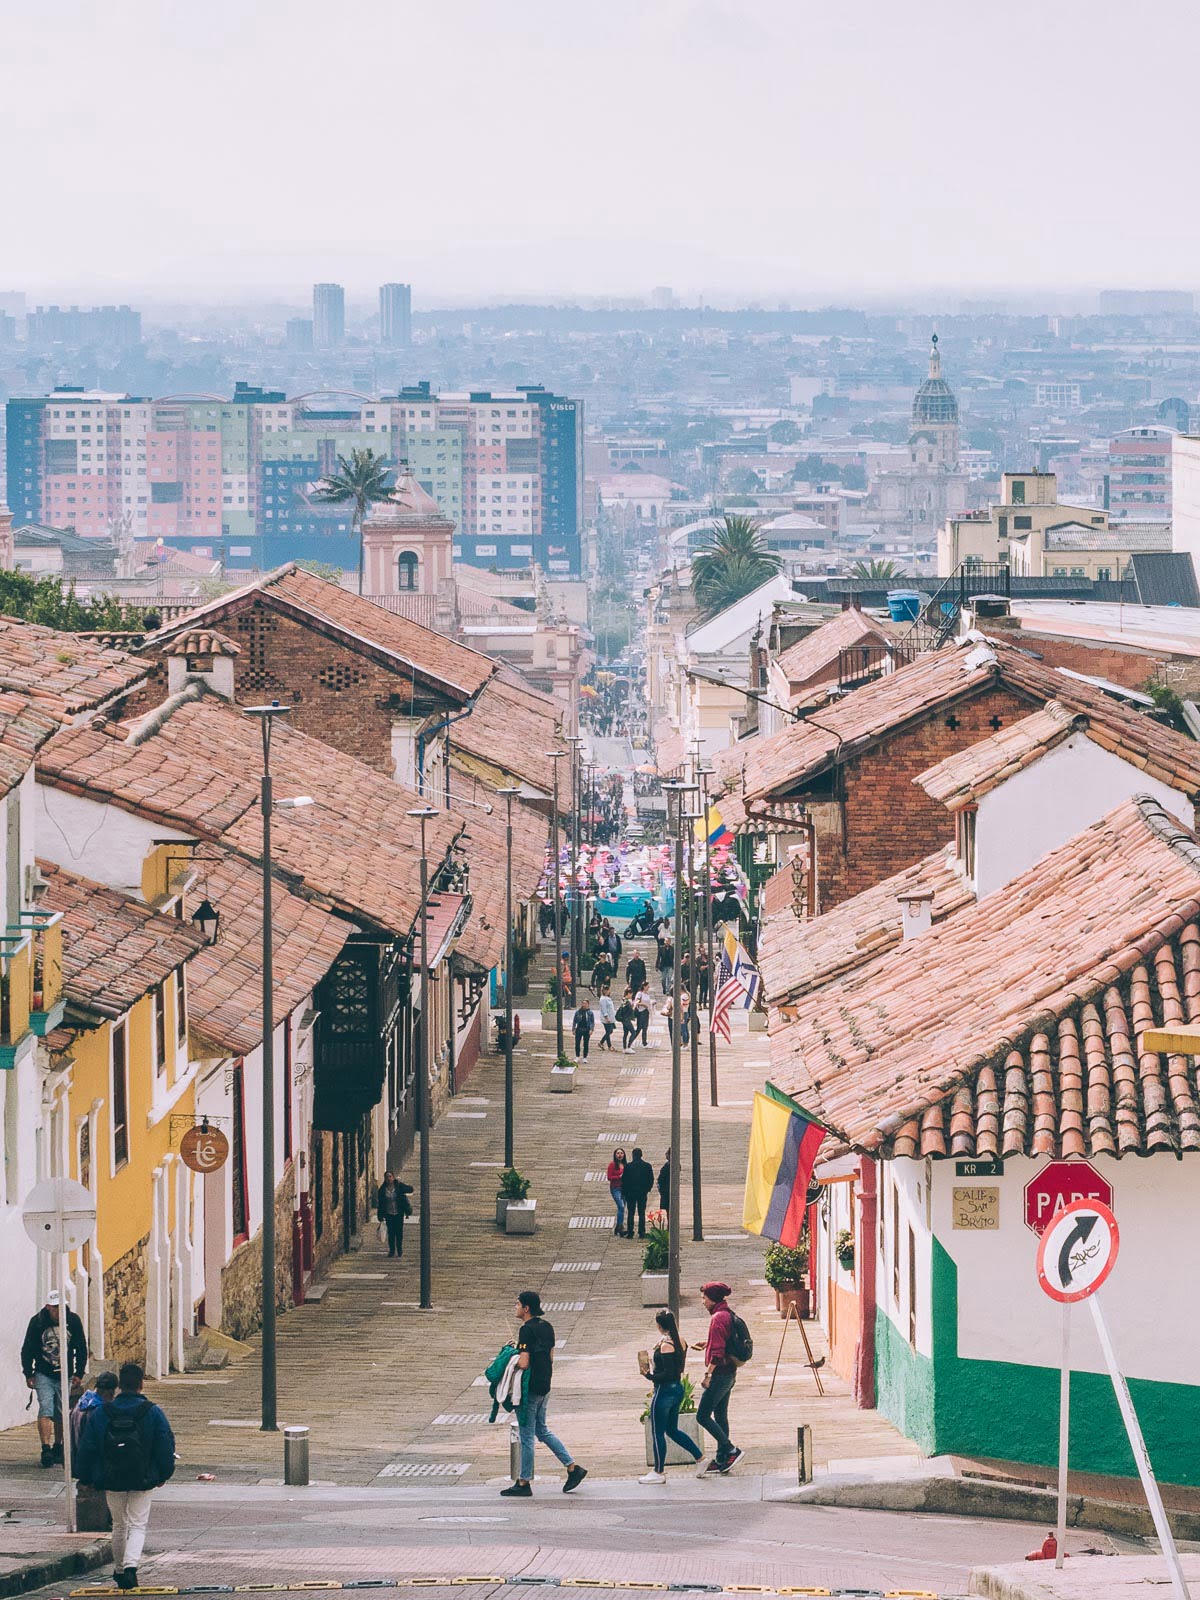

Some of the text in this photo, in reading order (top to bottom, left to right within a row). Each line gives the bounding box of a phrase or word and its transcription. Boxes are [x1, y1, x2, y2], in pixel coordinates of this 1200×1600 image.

[964, 1163, 997, 1174] KR 2
[1036, 1192, 1100, 1219] PA
